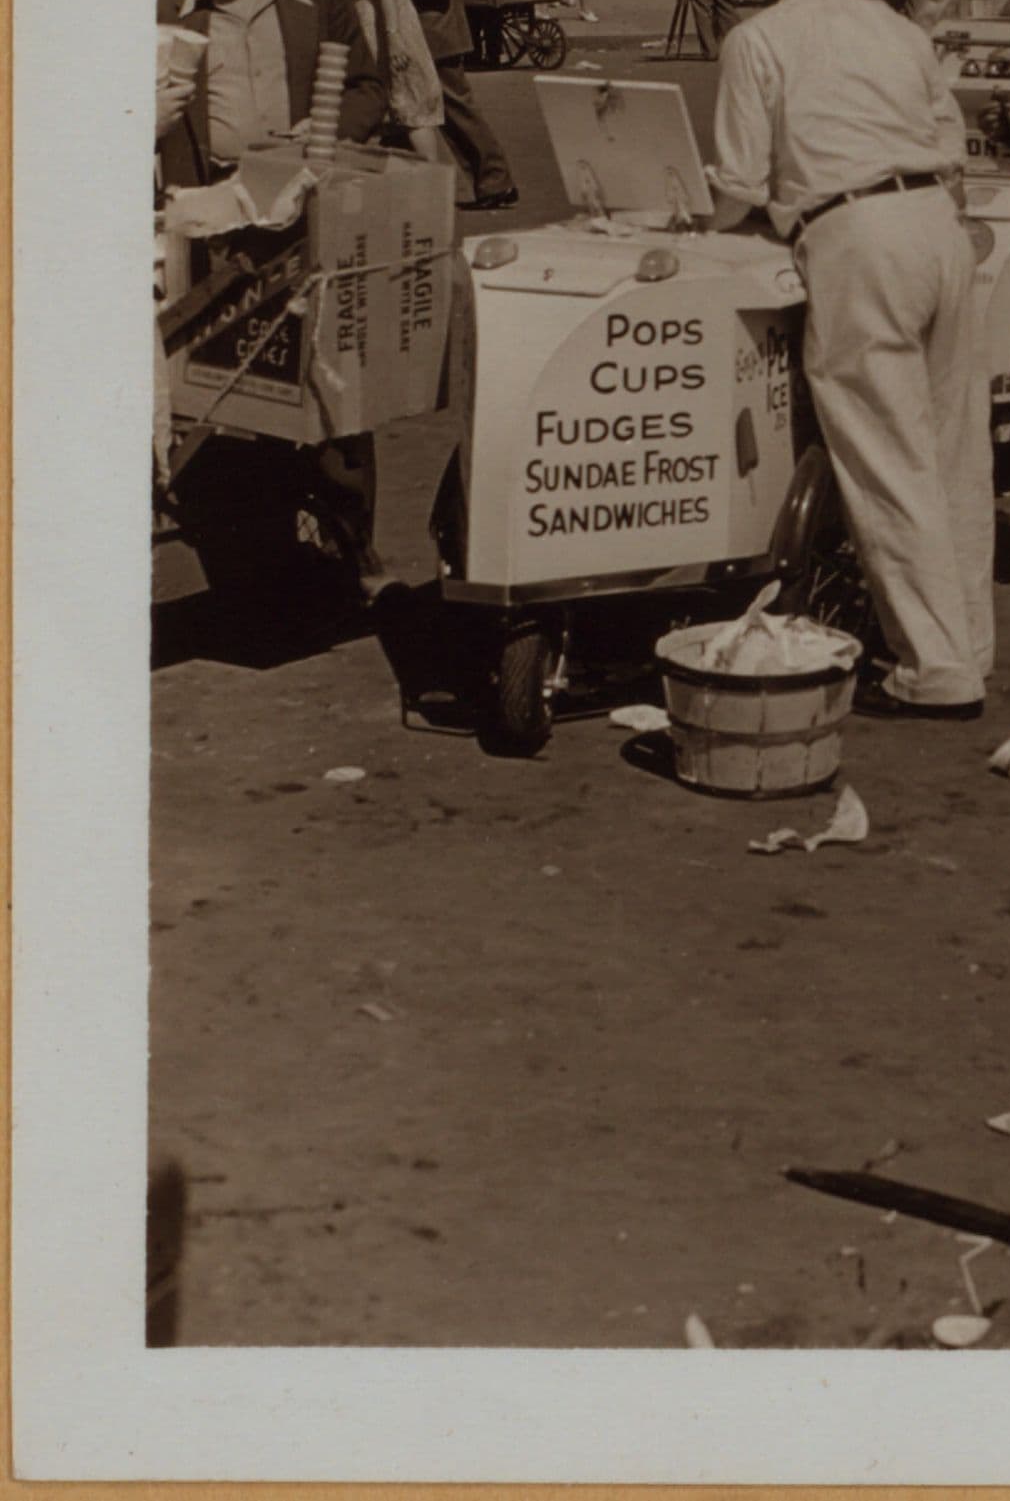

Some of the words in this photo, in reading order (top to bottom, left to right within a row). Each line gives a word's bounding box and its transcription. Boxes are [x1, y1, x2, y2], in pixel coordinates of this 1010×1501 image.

[607, 313, 703, 347] POPS
[589, 361, 706, 395] CUPS
[536, 410, 694, 447] FUDGES
[525, 459, 636, 494] SUNDAE
[643, 449, 720, 485] FROST
[528, 496, 709, 538] SANDWICHES
